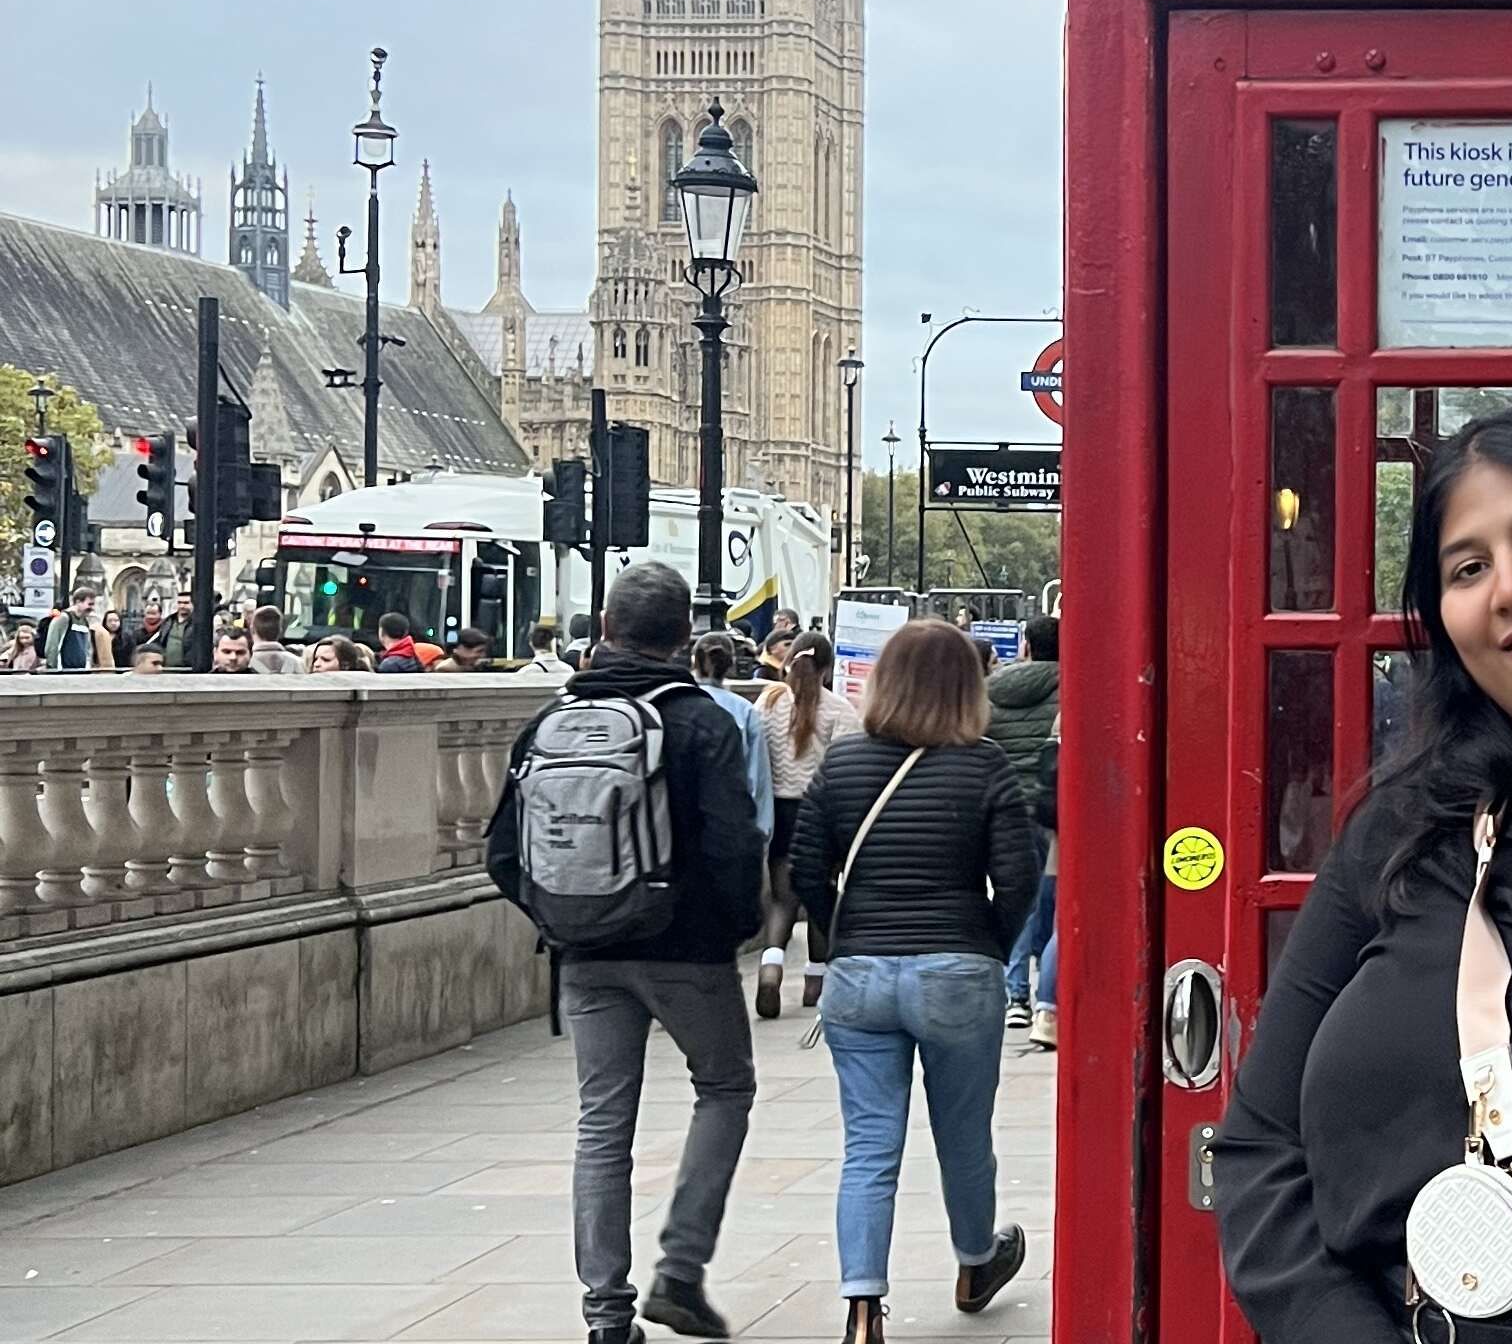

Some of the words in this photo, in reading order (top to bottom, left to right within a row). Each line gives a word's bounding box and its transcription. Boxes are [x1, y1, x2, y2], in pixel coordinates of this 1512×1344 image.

[1403, 142, 1446, 161] This
[1450, 141, 1503, 162] kiosk
[1403, 168, 1465, 187] future
[966, 467, 1062, 485] Westmin
[957, 485, 1001, 497] Public
[1003, 486, 1056, 500] Subway
